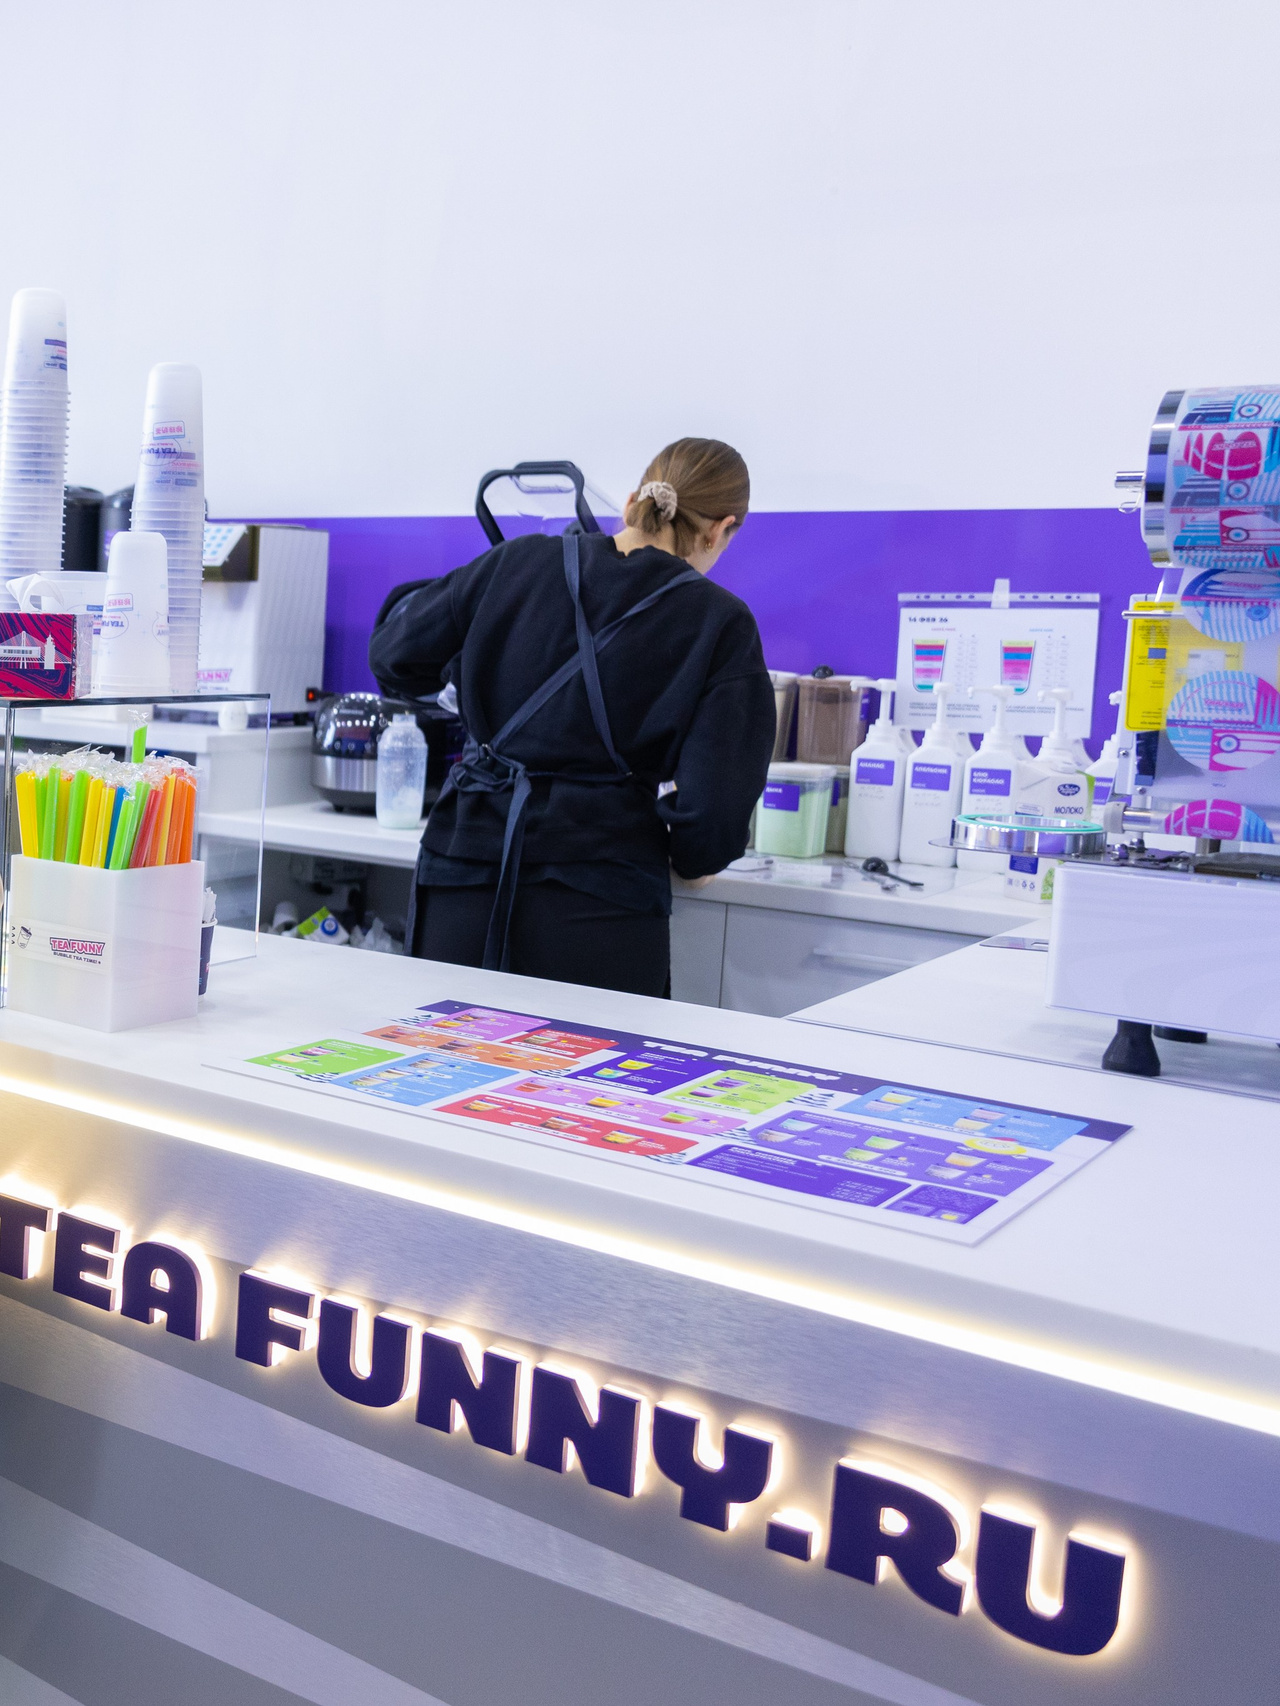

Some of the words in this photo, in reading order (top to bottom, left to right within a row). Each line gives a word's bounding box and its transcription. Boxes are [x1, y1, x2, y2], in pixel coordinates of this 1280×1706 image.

[1054, 806, 1084, 815] МОЛОКО
[51, 938, 69, 951] TEA
[70, 939, 104, 955] FUNNY
[643, 1040, 709, 1058] TEA
[235, 1269, 1127, 1657] FUNNY.RU
